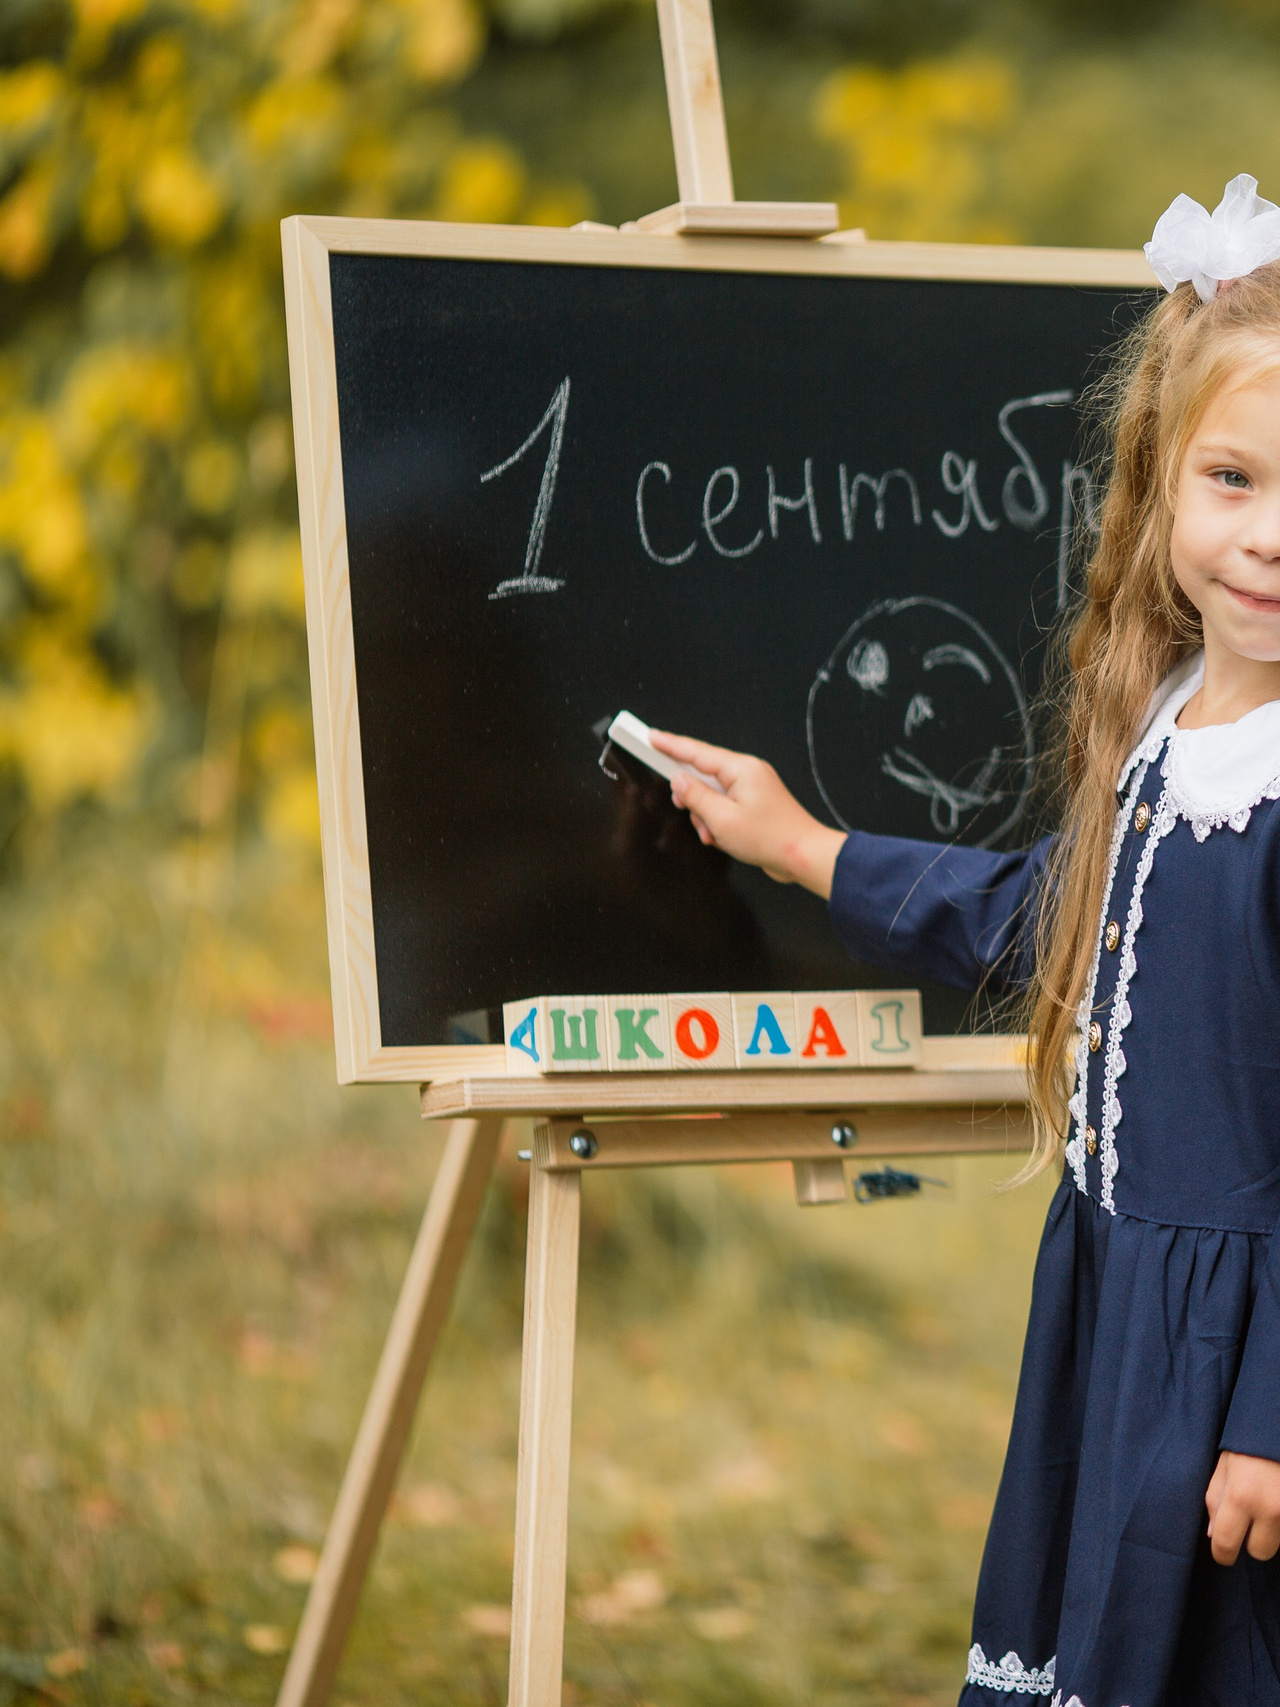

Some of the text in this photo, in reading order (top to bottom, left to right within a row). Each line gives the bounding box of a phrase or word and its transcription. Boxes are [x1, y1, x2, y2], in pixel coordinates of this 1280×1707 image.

[480, 374, 1105, 610] 1 сентябр
[549, 1003, 847, 1061] ШКОЛА
